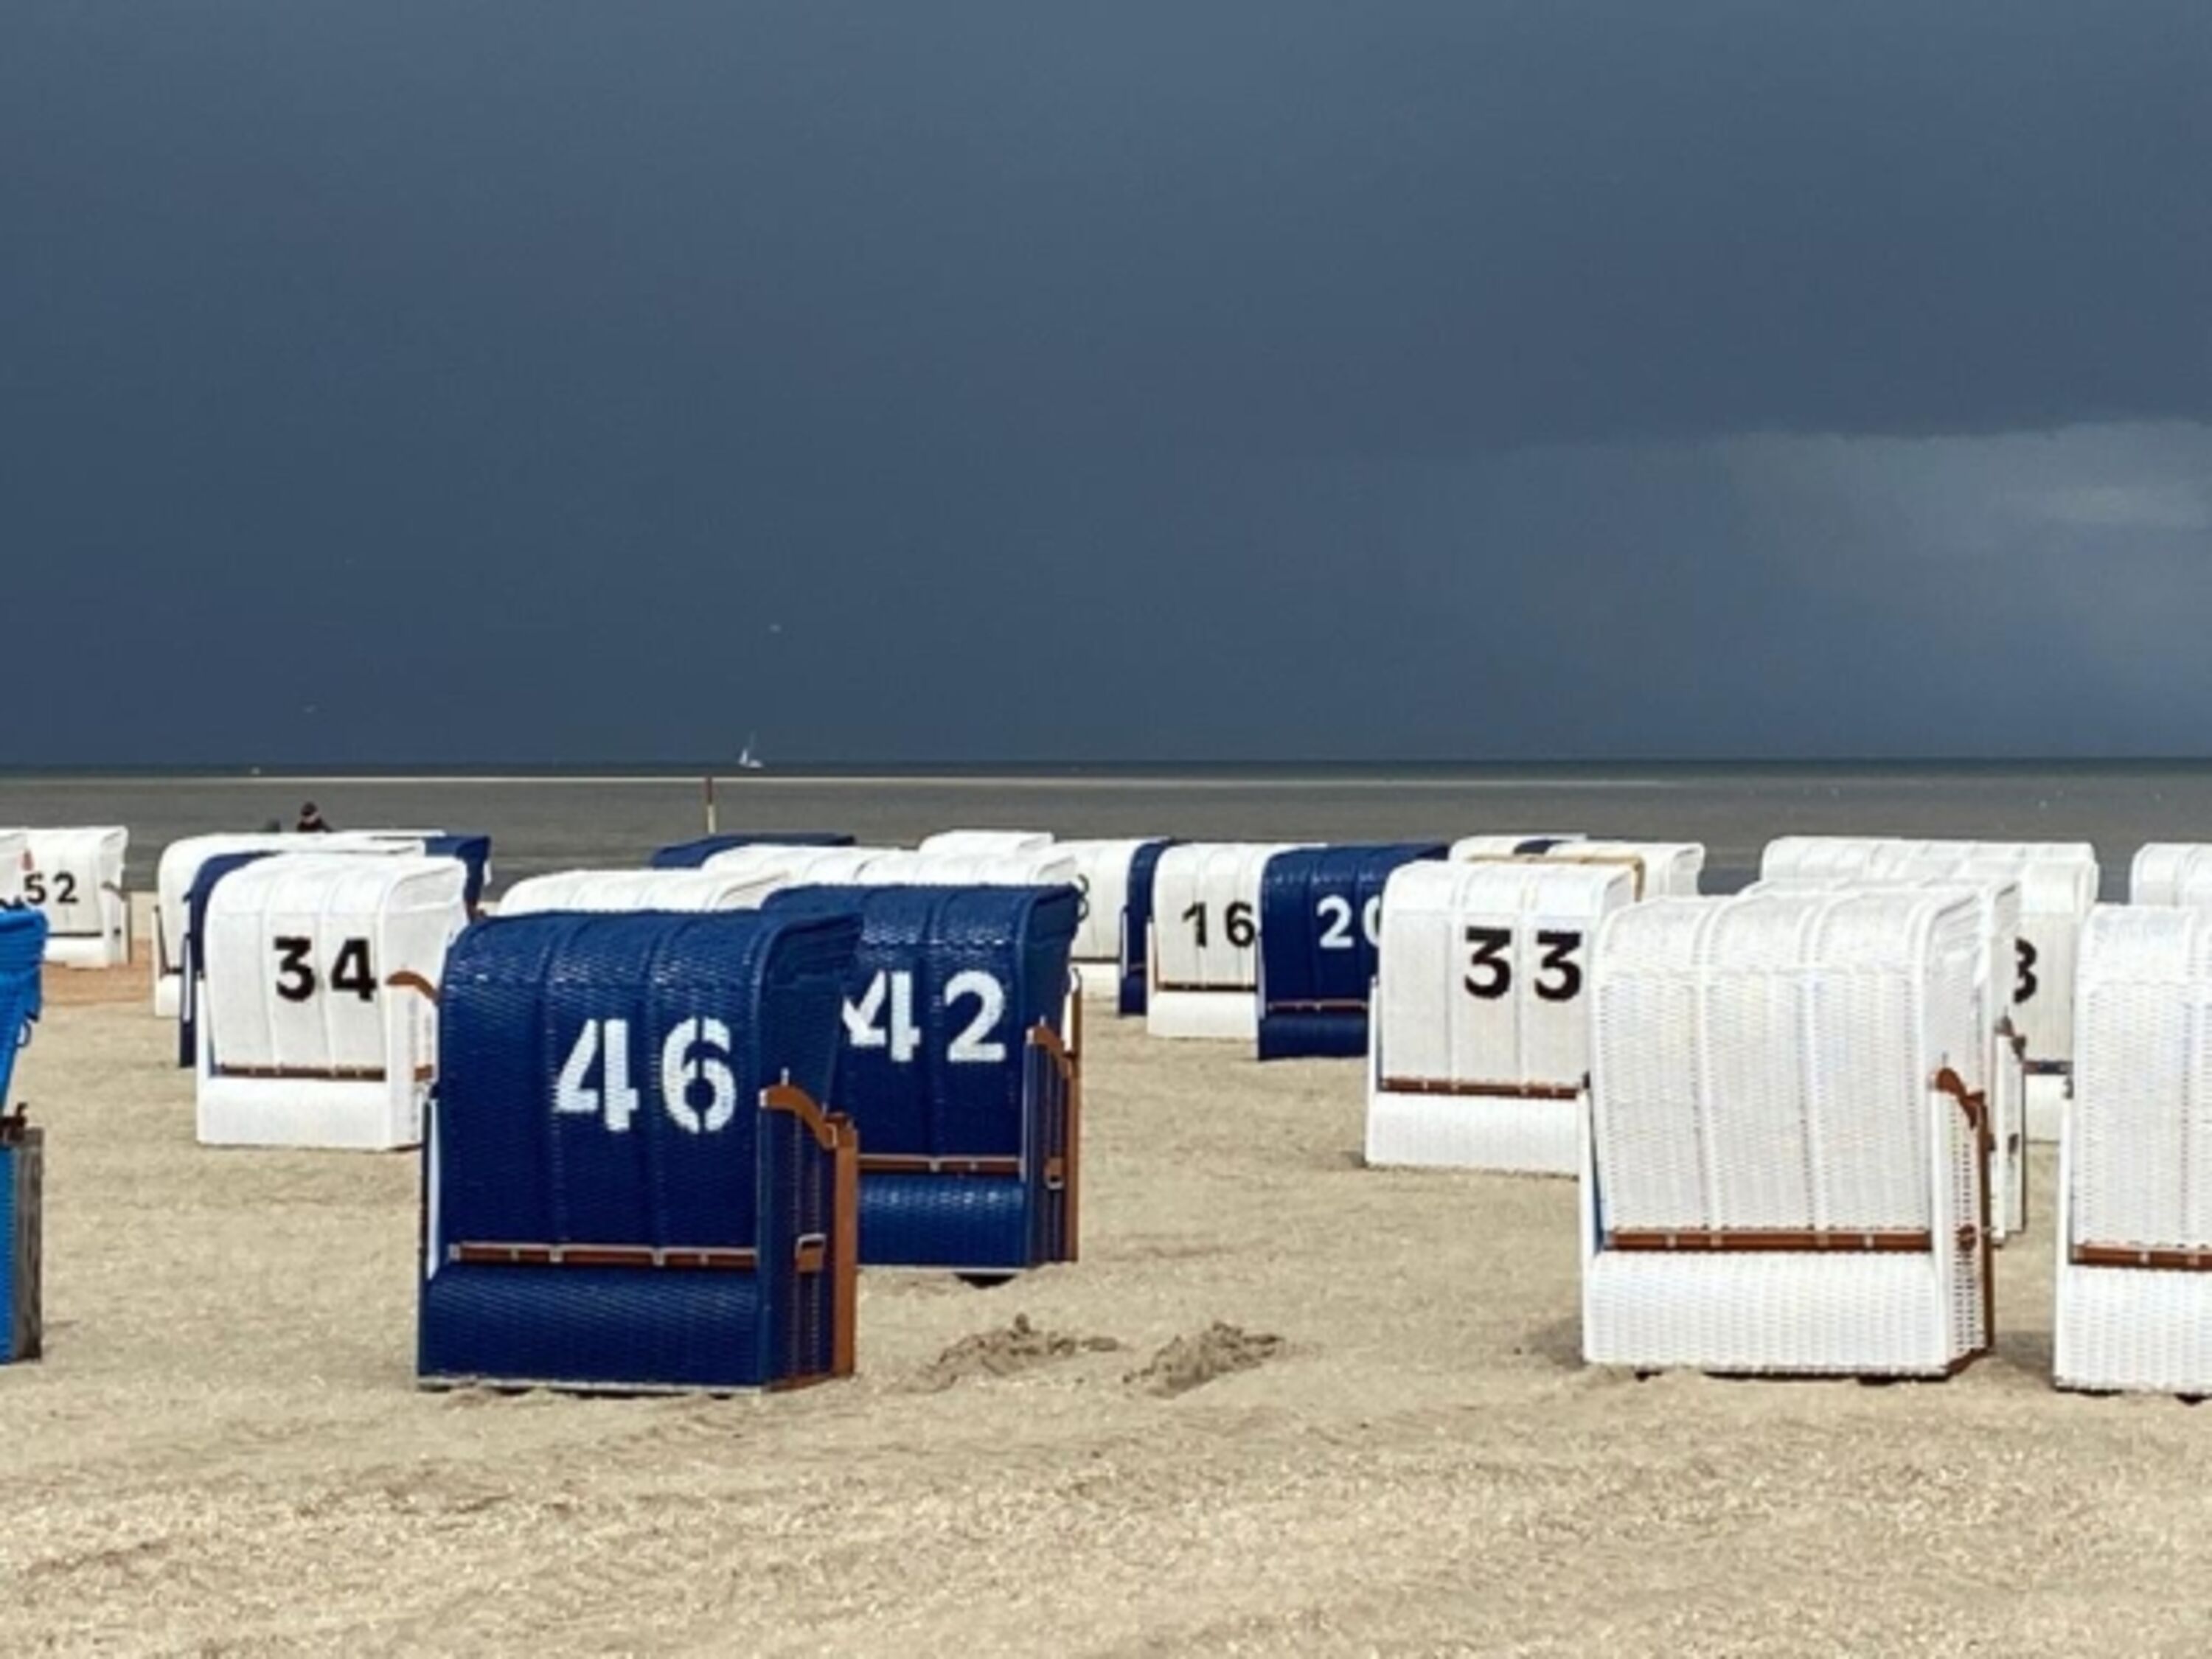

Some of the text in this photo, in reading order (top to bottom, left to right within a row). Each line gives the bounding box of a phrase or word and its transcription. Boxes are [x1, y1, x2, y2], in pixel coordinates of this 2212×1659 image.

[24, 871, 80, 906] 52
[1181, 900, 1256, 949] 16
[274, 936, 378, 1003] 34
[1464, 926, 1582, 1002] 33
[842, 970, 1006, 1062] 42
[553, 1017, 737, 1133] 46
